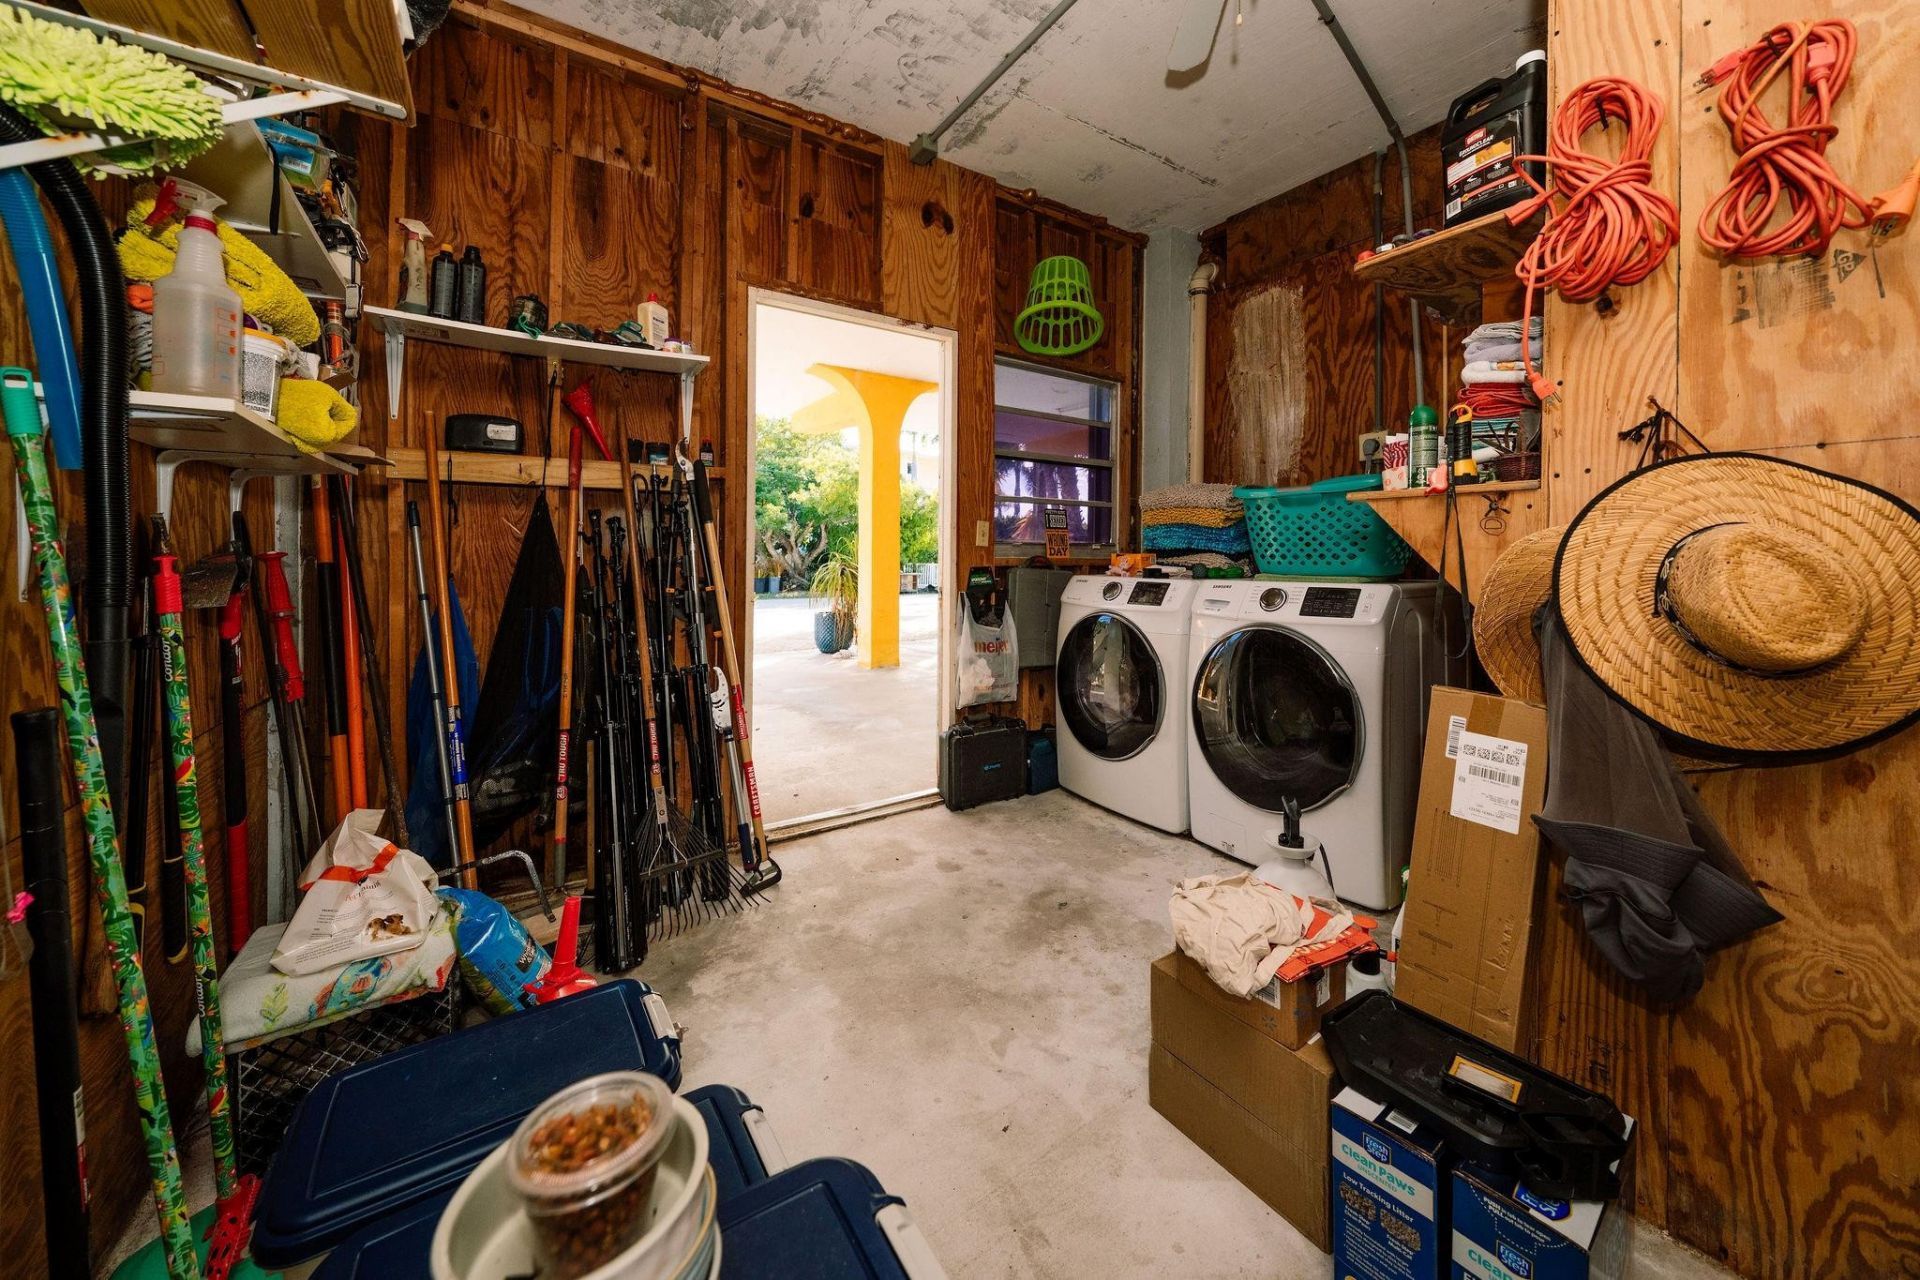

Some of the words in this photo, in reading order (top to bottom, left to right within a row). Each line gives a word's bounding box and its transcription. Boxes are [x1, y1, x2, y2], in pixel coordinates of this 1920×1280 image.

[1049, 547, 1068, 556] DAY
[973, 637, 1009, 656] meijer
[648, 722, 657, 745] TOUGH
[559, 734, 567, 761] TOUGH
[747, 766, 761, 815] CRAFTSMAN
[1365, 1136, 1389, 1156] Fresh
[1366, 1145, 1387, 1162] Step
[1341, 1143, 1377, 1172] Clean
[1378, 1165, 1416, 1197] Paws
[1357, 1165, 1397, 1193] UNSCENTED
[1342, 1171, 1359, 1188] Low
[1359, 1181, 1391, 1209] Tracking
[1392, 1202, 1414, 1222] Litter
[1500, 1245, 1529, 1270] Fresh
[1501, 1257, 1528, 1277] Step
